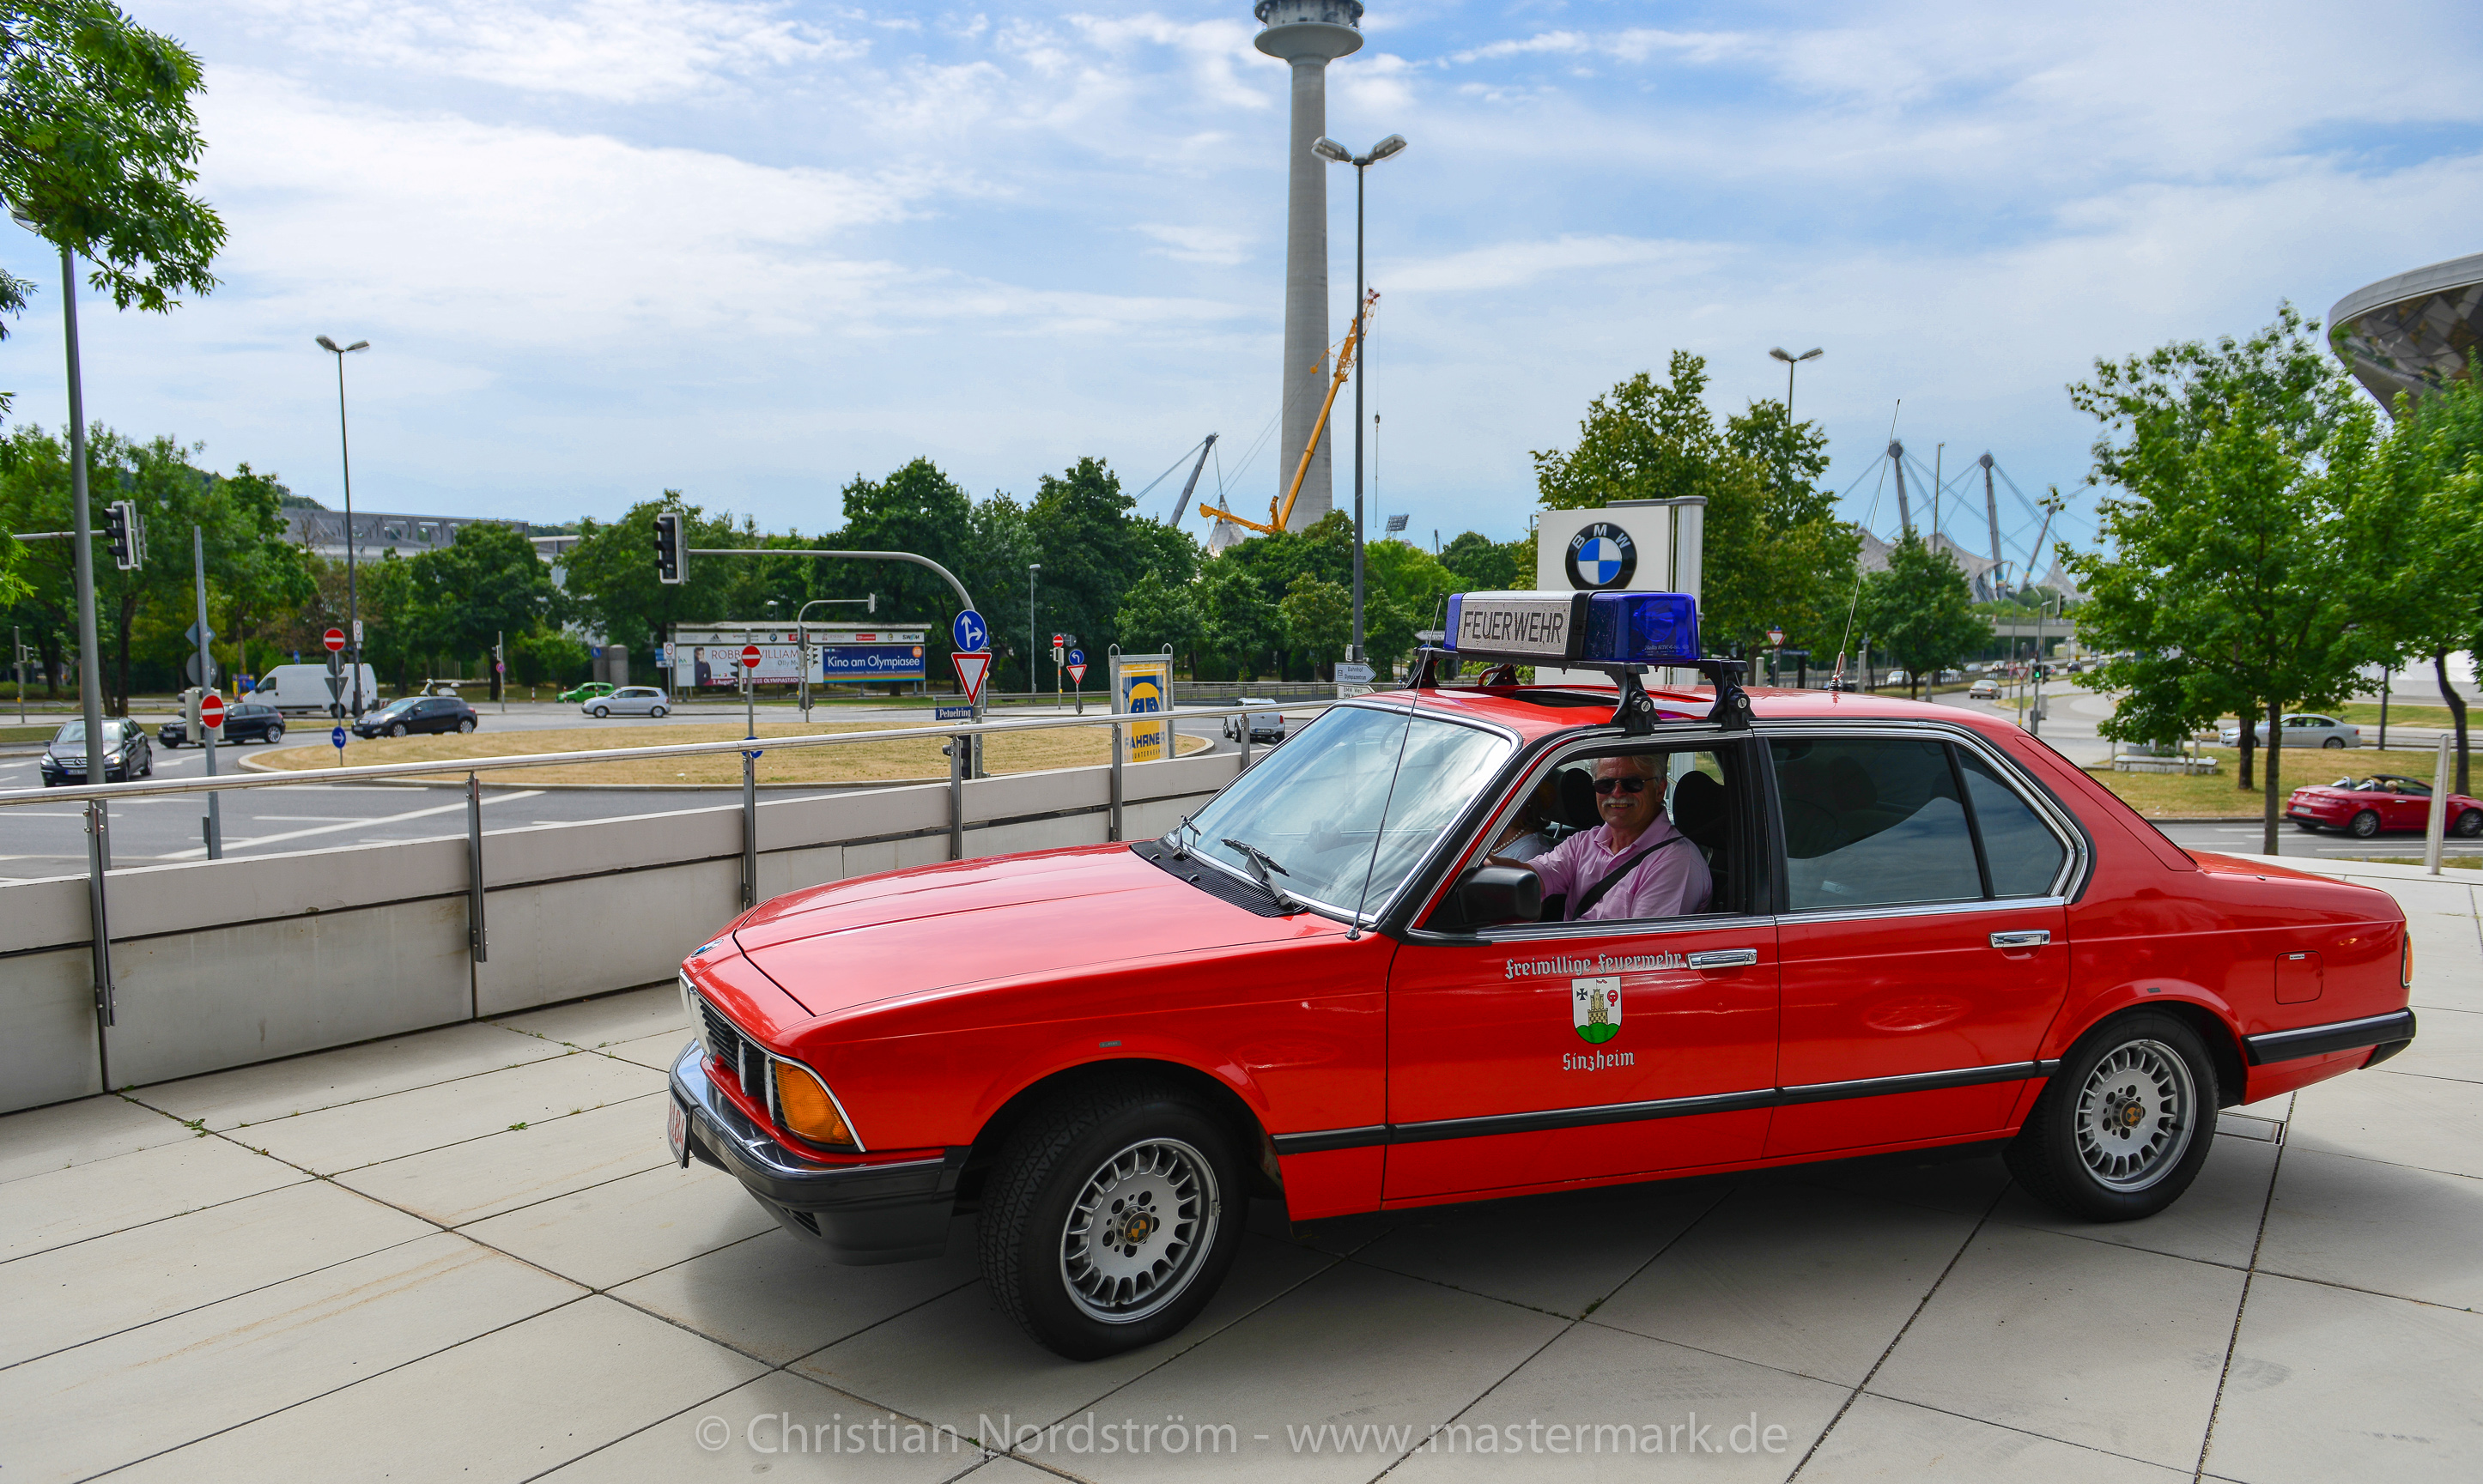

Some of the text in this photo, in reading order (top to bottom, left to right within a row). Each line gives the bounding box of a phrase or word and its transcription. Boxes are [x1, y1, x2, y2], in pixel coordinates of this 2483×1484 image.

[1572, 524, 1631, 549] BMW
[1461, 610, 1564, 644] FEUERWEHR
[711, 649, 799, 660] ROBB ILLIAM
[828, 656, 849, 667] Kino
[867, 655, 920, 669] Olympiasee
[939, 707, 971, 719] Petuelring
[1124, 731, 1166, 750] FAHRNER
[1504, 950, 1682, 980] Freiwillige Feuerwehr
[1563, 1049, 1635, 1072] Sinzheim
